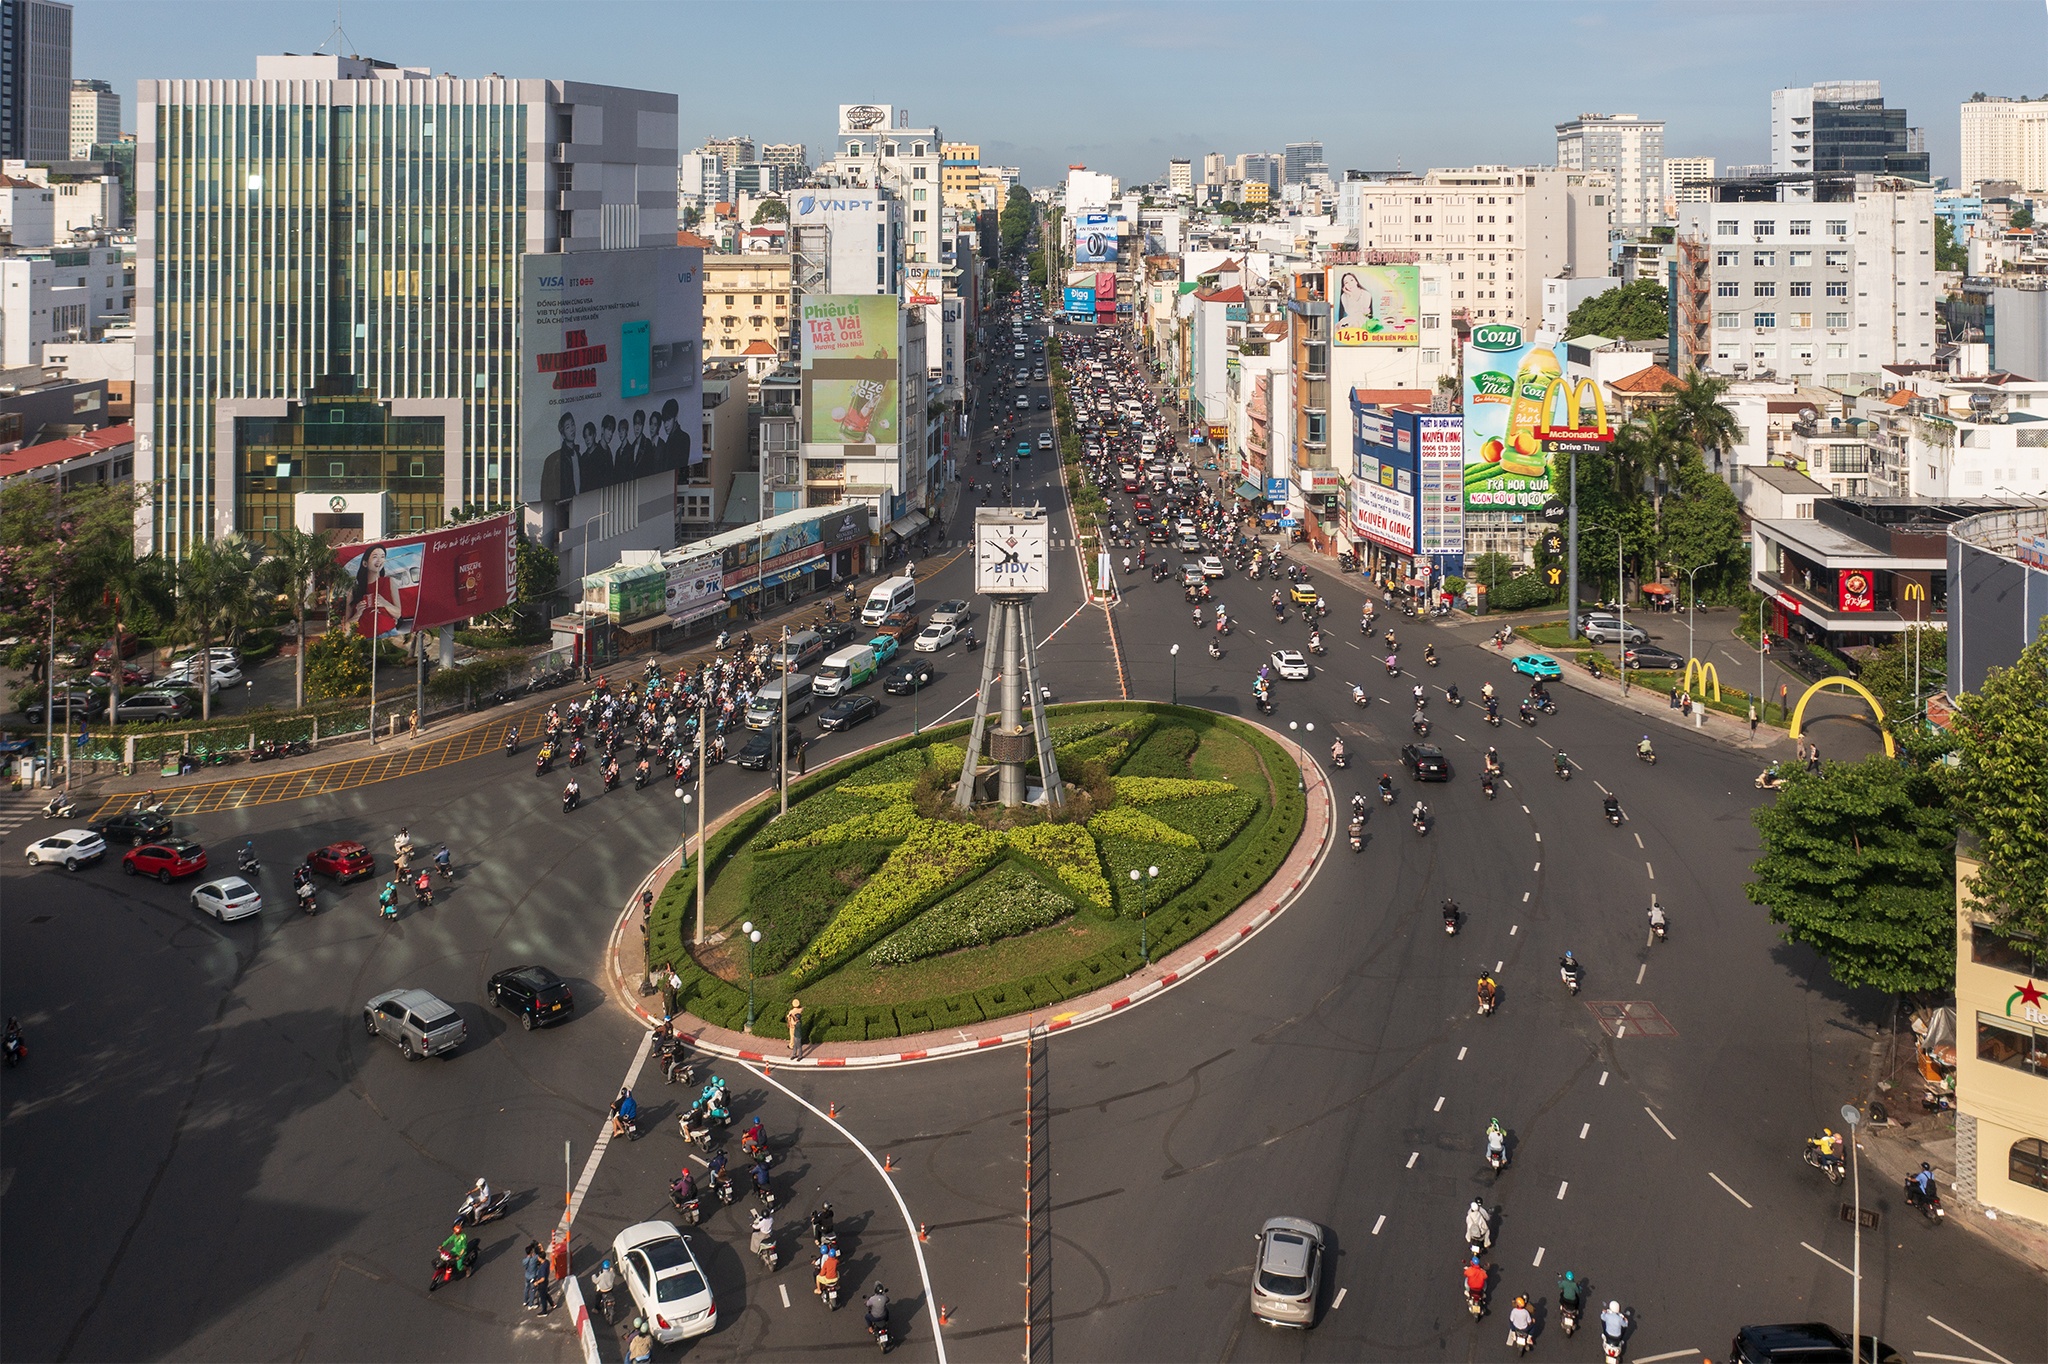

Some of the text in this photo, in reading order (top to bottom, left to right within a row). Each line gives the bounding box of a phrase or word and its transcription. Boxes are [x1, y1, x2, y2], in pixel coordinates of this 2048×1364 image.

[820, 199, 873, 211] VNPT
[678, 272, 692, 283] VIB
[911, 268, 921, 277] QS
[538, 277, 564, 286] VISA
[804, 303, 846, 319] Phiêu
[944, 310, 956, 322] QS
[808, 316, 860, 332] Trà Vải
[568, 330, 586, 348] BTS
[812, 330, 862, 343] Mật Ong
[1337, 331, 1368, 341] 14-16
[1477, 329, 1517, 345] Cozy
[540, 348, 604, 370] WORLD TOUR
[554, 368, 596, 388] ARIRANG
[1482, 381, 1509, 394] Mới
[1363, 423, 1379, 432] Panasonic
[1445, 432, 1461, 442] GIANG
[1549, 430, 1598, 439] McDonald's
[1487, 476, 1549, 490] TRÀ HOA QUẢ
[1471, 492, 1540, 506] NGON RÕ VỊ VỊ RÕ
[1389, 520, 1411, 539] GIANG
[711, 558, 721, 570] 7K
[994, 563, 1028, 573] BIDV
[705, 580, 719, 596] 7K
